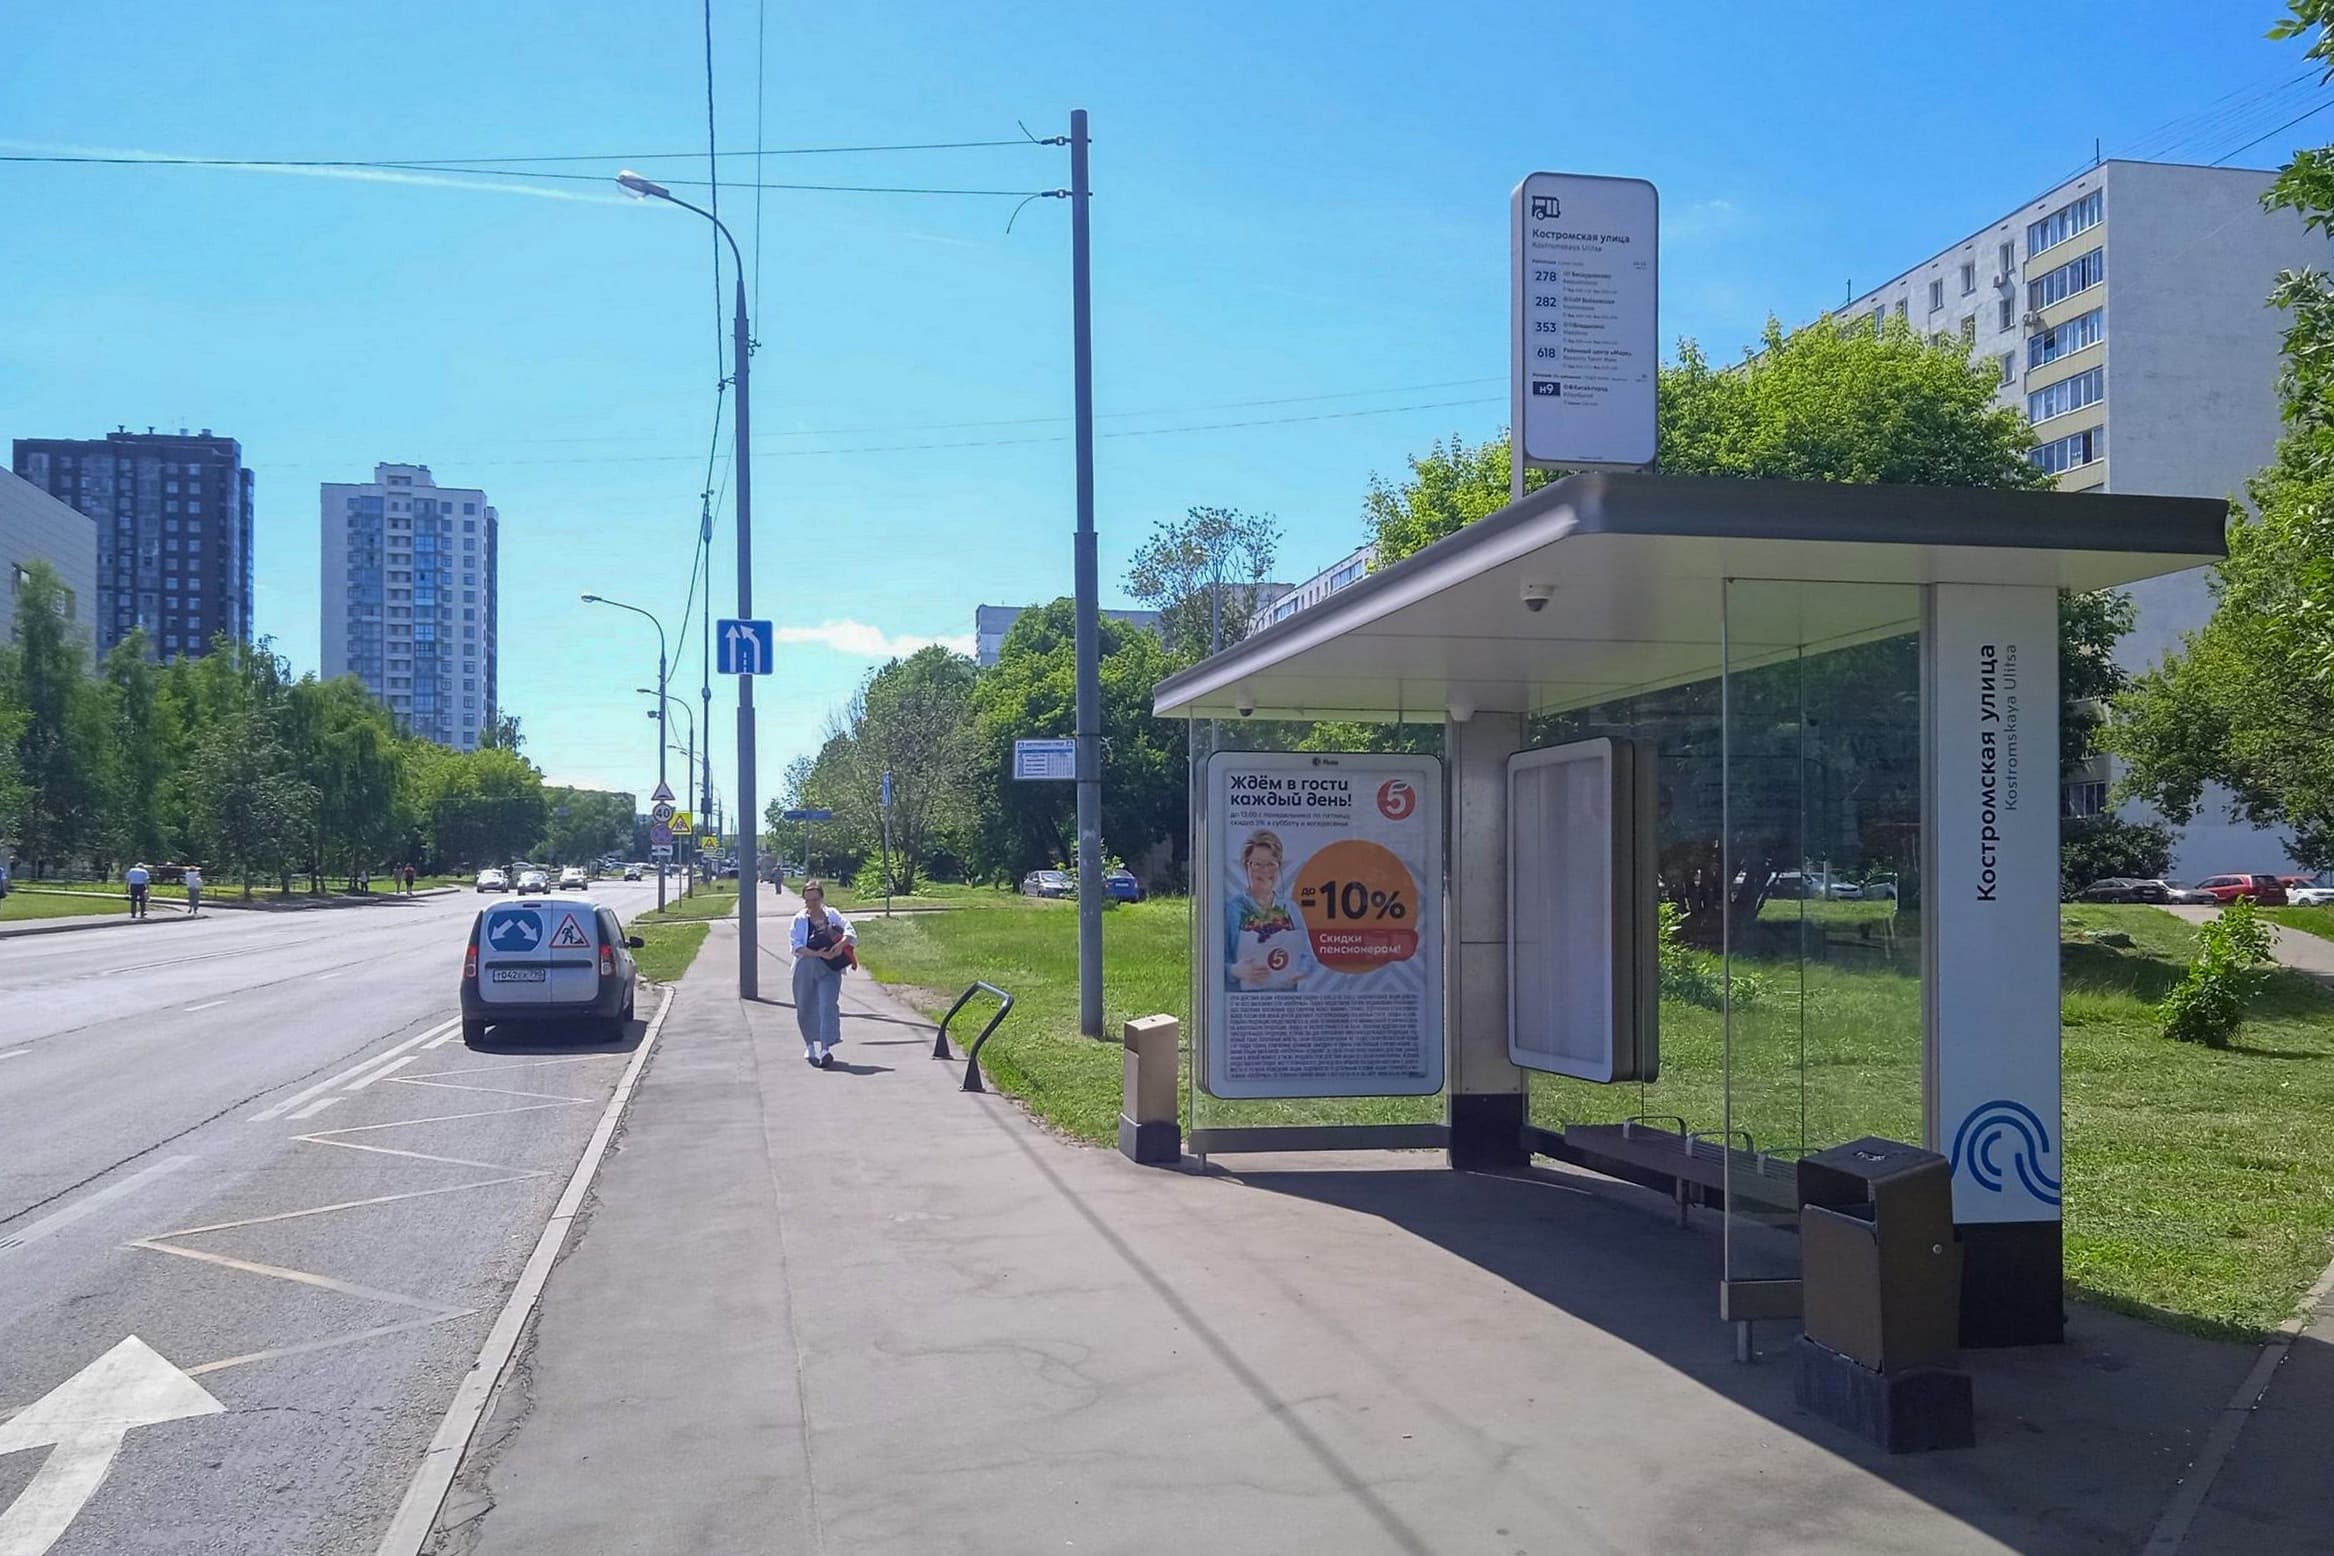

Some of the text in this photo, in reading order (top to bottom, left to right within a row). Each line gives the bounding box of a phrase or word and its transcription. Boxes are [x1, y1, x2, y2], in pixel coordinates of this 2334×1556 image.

[1532, 229, 1630, 244] Костромская улица
[1535, 270, 1557, 282] 278
[1535, 296, 1557, 308] 282
[1535, 321, 1557, 333] 353
[1537, 347, 1556, 359] 618
[2003, 644, 2019, 810] Kostromskaya Ulitsa
[1977, 644, 2001, 901] Костромская улица
[1230, 774, 1348, 791] Ждём в гости
[1230, 791, 1352, 807] каждый день!
[656, 808, 670, 818] 40
[1301, 887, 1316, 896] до
[1319, 933, 1362, 944] Скидки
[1319, 944, 1402, 956] пенсионерам!
[1272, 949, 1285, 968] 5
